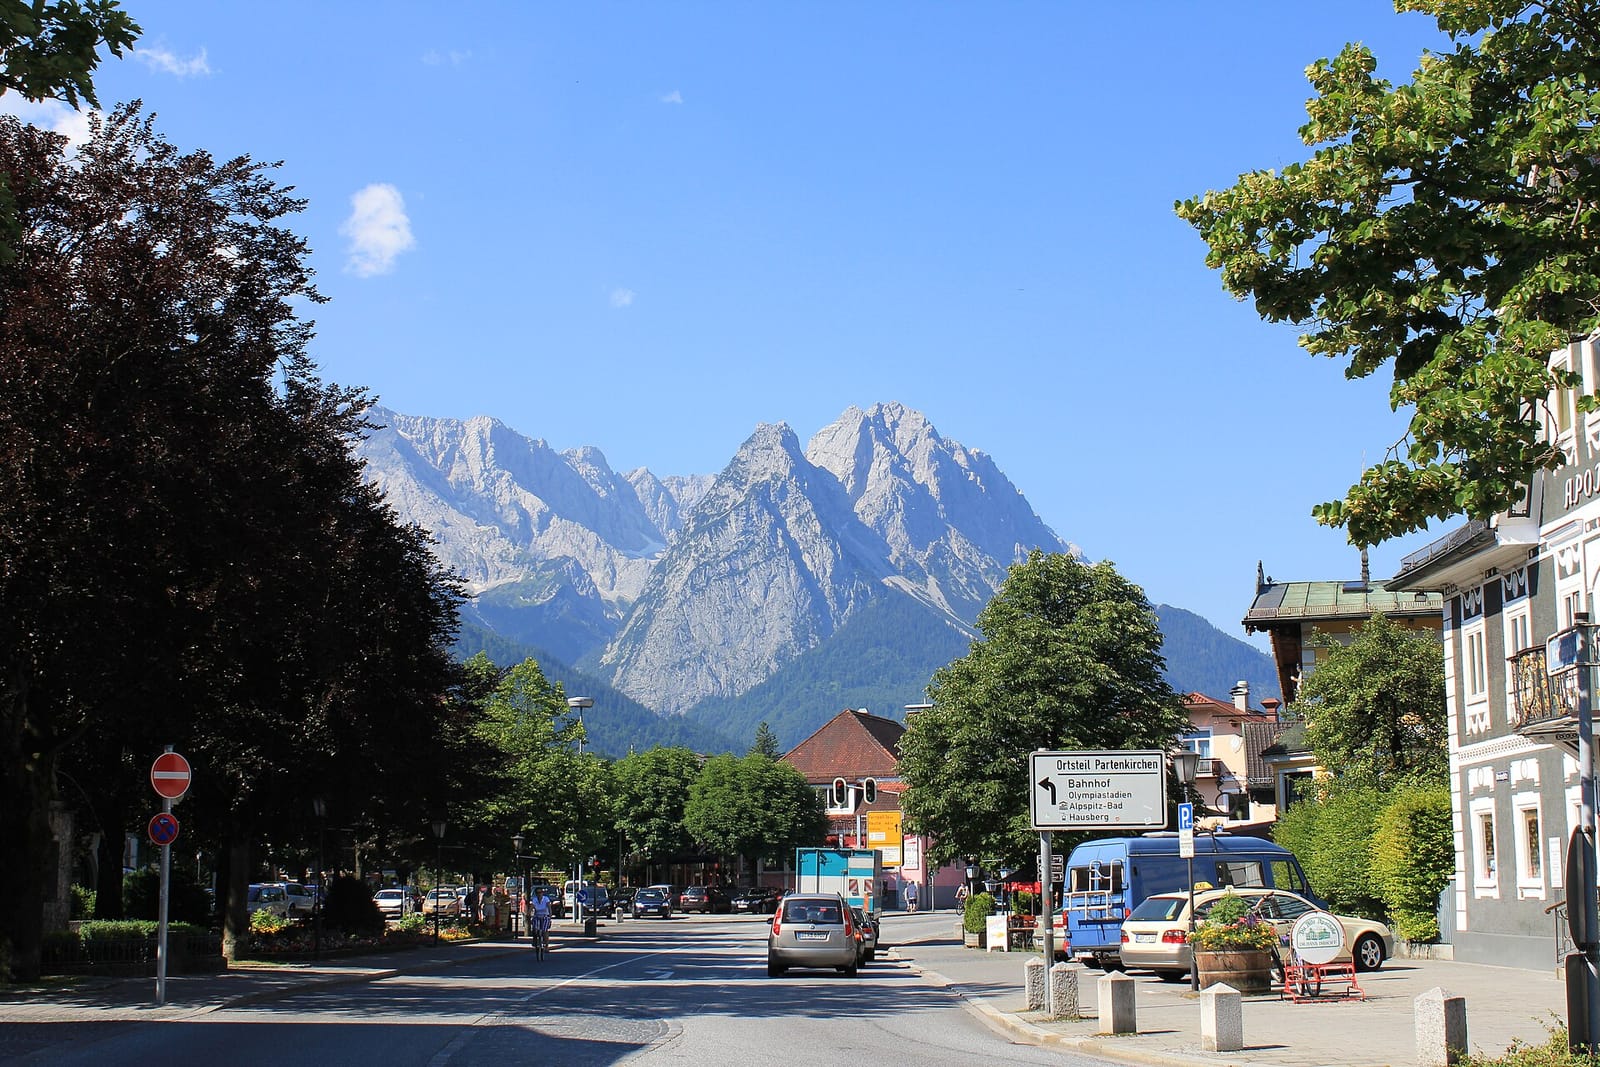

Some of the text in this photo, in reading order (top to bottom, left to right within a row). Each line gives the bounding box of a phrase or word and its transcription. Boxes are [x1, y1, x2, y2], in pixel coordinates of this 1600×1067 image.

[1056, 758, 1158, 770] Ortsteil Partenkirchen
[1068, 779, 1111, 788] Bahnhof
[1068, 791, 1132, 800] Olympiastadien
[1069, 801, 1123, 811] Alpspitz-Bad
[1069, 813, 1109, 822] Hausberg
[1181, 807, 1190, 828] P
